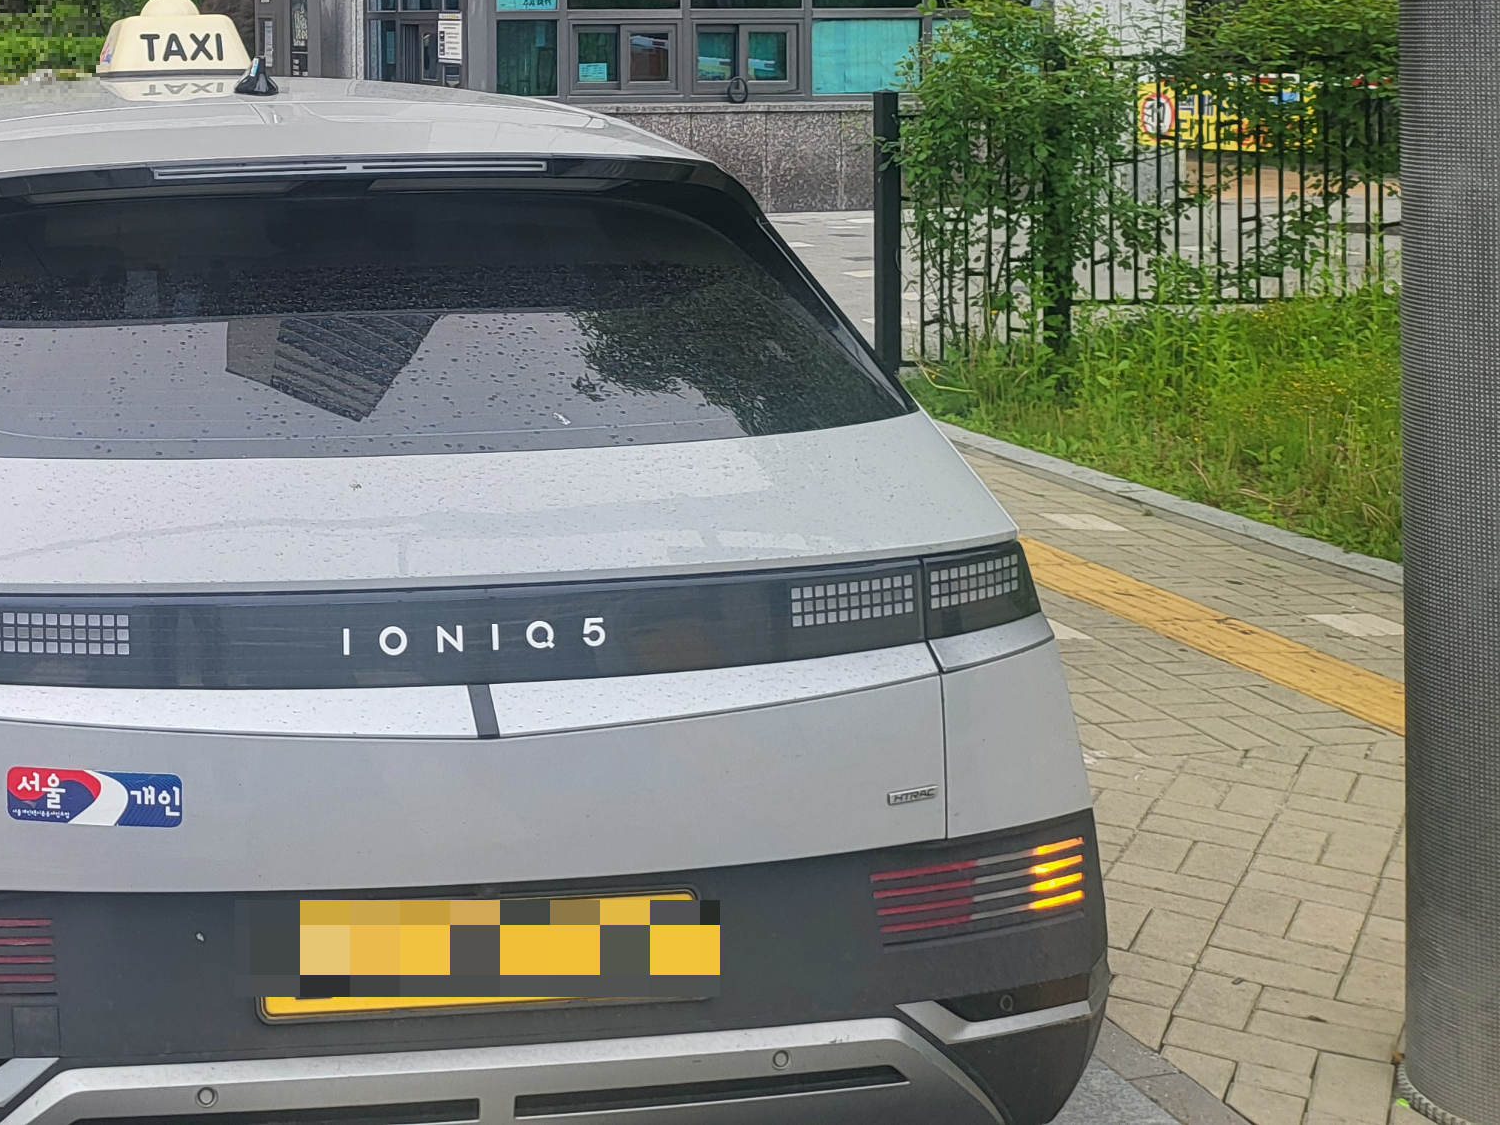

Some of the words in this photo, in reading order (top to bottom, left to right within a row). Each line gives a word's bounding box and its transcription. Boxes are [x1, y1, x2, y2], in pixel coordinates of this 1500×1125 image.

[139, 33, 224, 62] TAXI
[342, 620, 555, 656] IONIQ
[582, 617, 606, 647] 5
[17, 772, 66, 810] 서울
[129, 785, 181, 817] 개인
[893, 788, 936, 803] HTRAC
